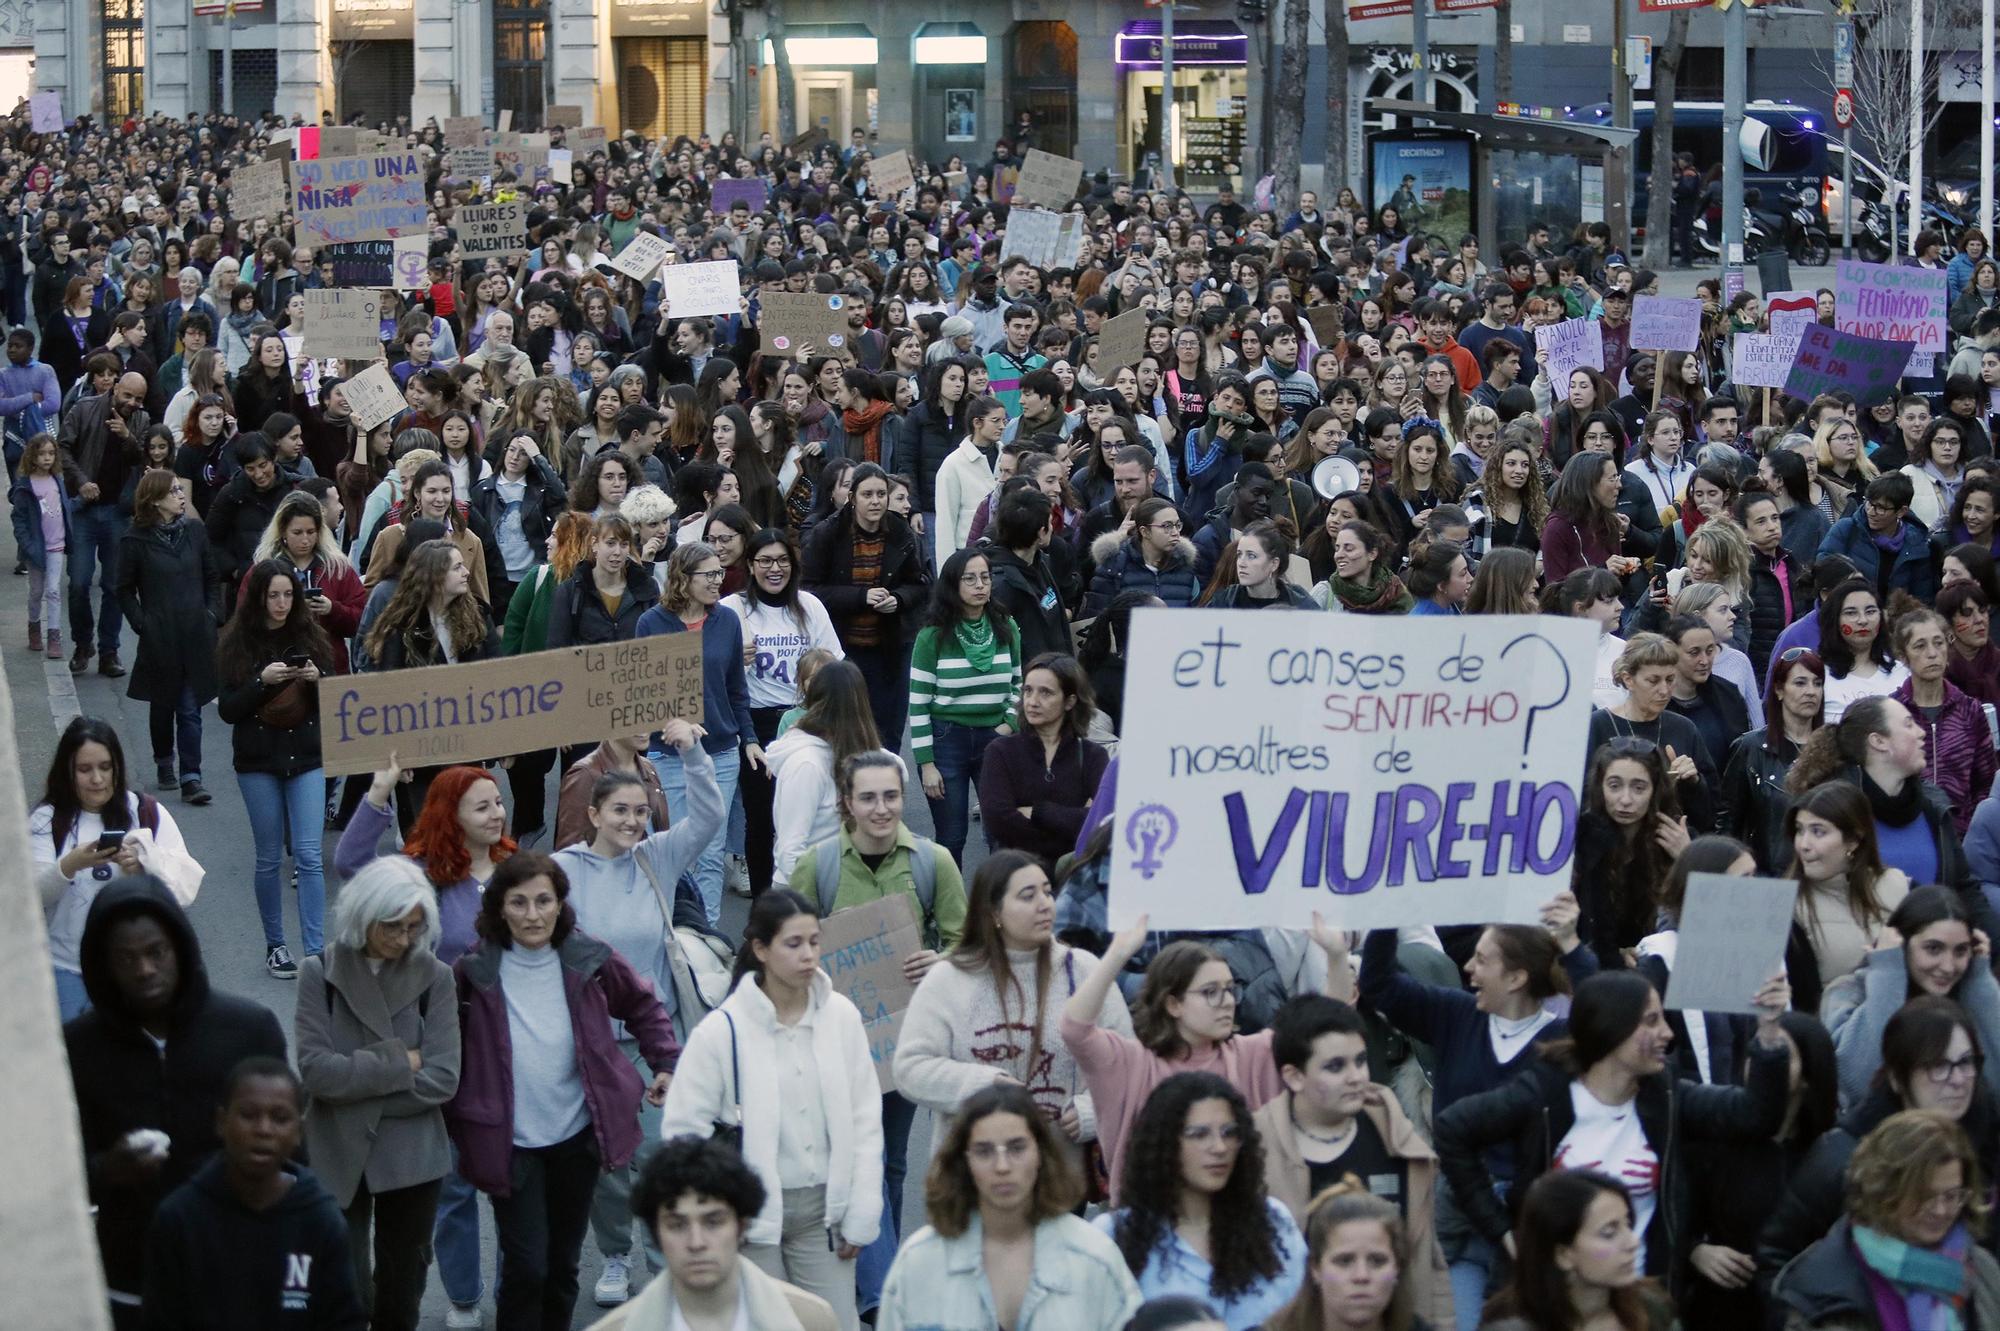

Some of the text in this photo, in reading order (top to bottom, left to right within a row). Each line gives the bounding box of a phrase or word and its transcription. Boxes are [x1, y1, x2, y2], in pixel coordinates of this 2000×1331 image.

[375, 154, 419, 178] UNA
[1399, 147, 1446, 159] DECATHLON
[298, 186, 354, 212] NIÑA
[463, 206, 517, 223] LLIURES
[482, 223, 498, 234] NO
[463, 235, 525, 252] VALENTES
[1844, 264, 1946, 290] LO CONTRARIO
[1838, 290, 1856, 305] AL
[1856, 287, 1930, 319] FEMINISMO
[1537, 319, 1586, 348] MANOLO
[1571, 339, 1583, 354] EL
[1810, 331, 1832, 351] EL
[1554, 354, 1583, 373] SOPAR
[1797, 350, 1823, 372] ME
[1825, 359, 1848, 378] DA
[777, 647, 797, 658] por
[1172, 625, 1242, 688] et
[1267, 646, 1406, 690] canses
[1438, 632, 1485, 683] de
[610, 655, 702, 685] radical que
[624, 682, 667, 703] dones
[334, 679, 565, 744] feminisme
[1322, 691, 1519, 733] SENTIR-HO
[416, 732, 467, 758] noun
[1169, 725, 1414, 778] nosaltres de
[1222, 779, 1578, 896] VIURE-HO
[819, 918, 897, 977] TAMBÉ
[286, 1253, 312, 1288] N
